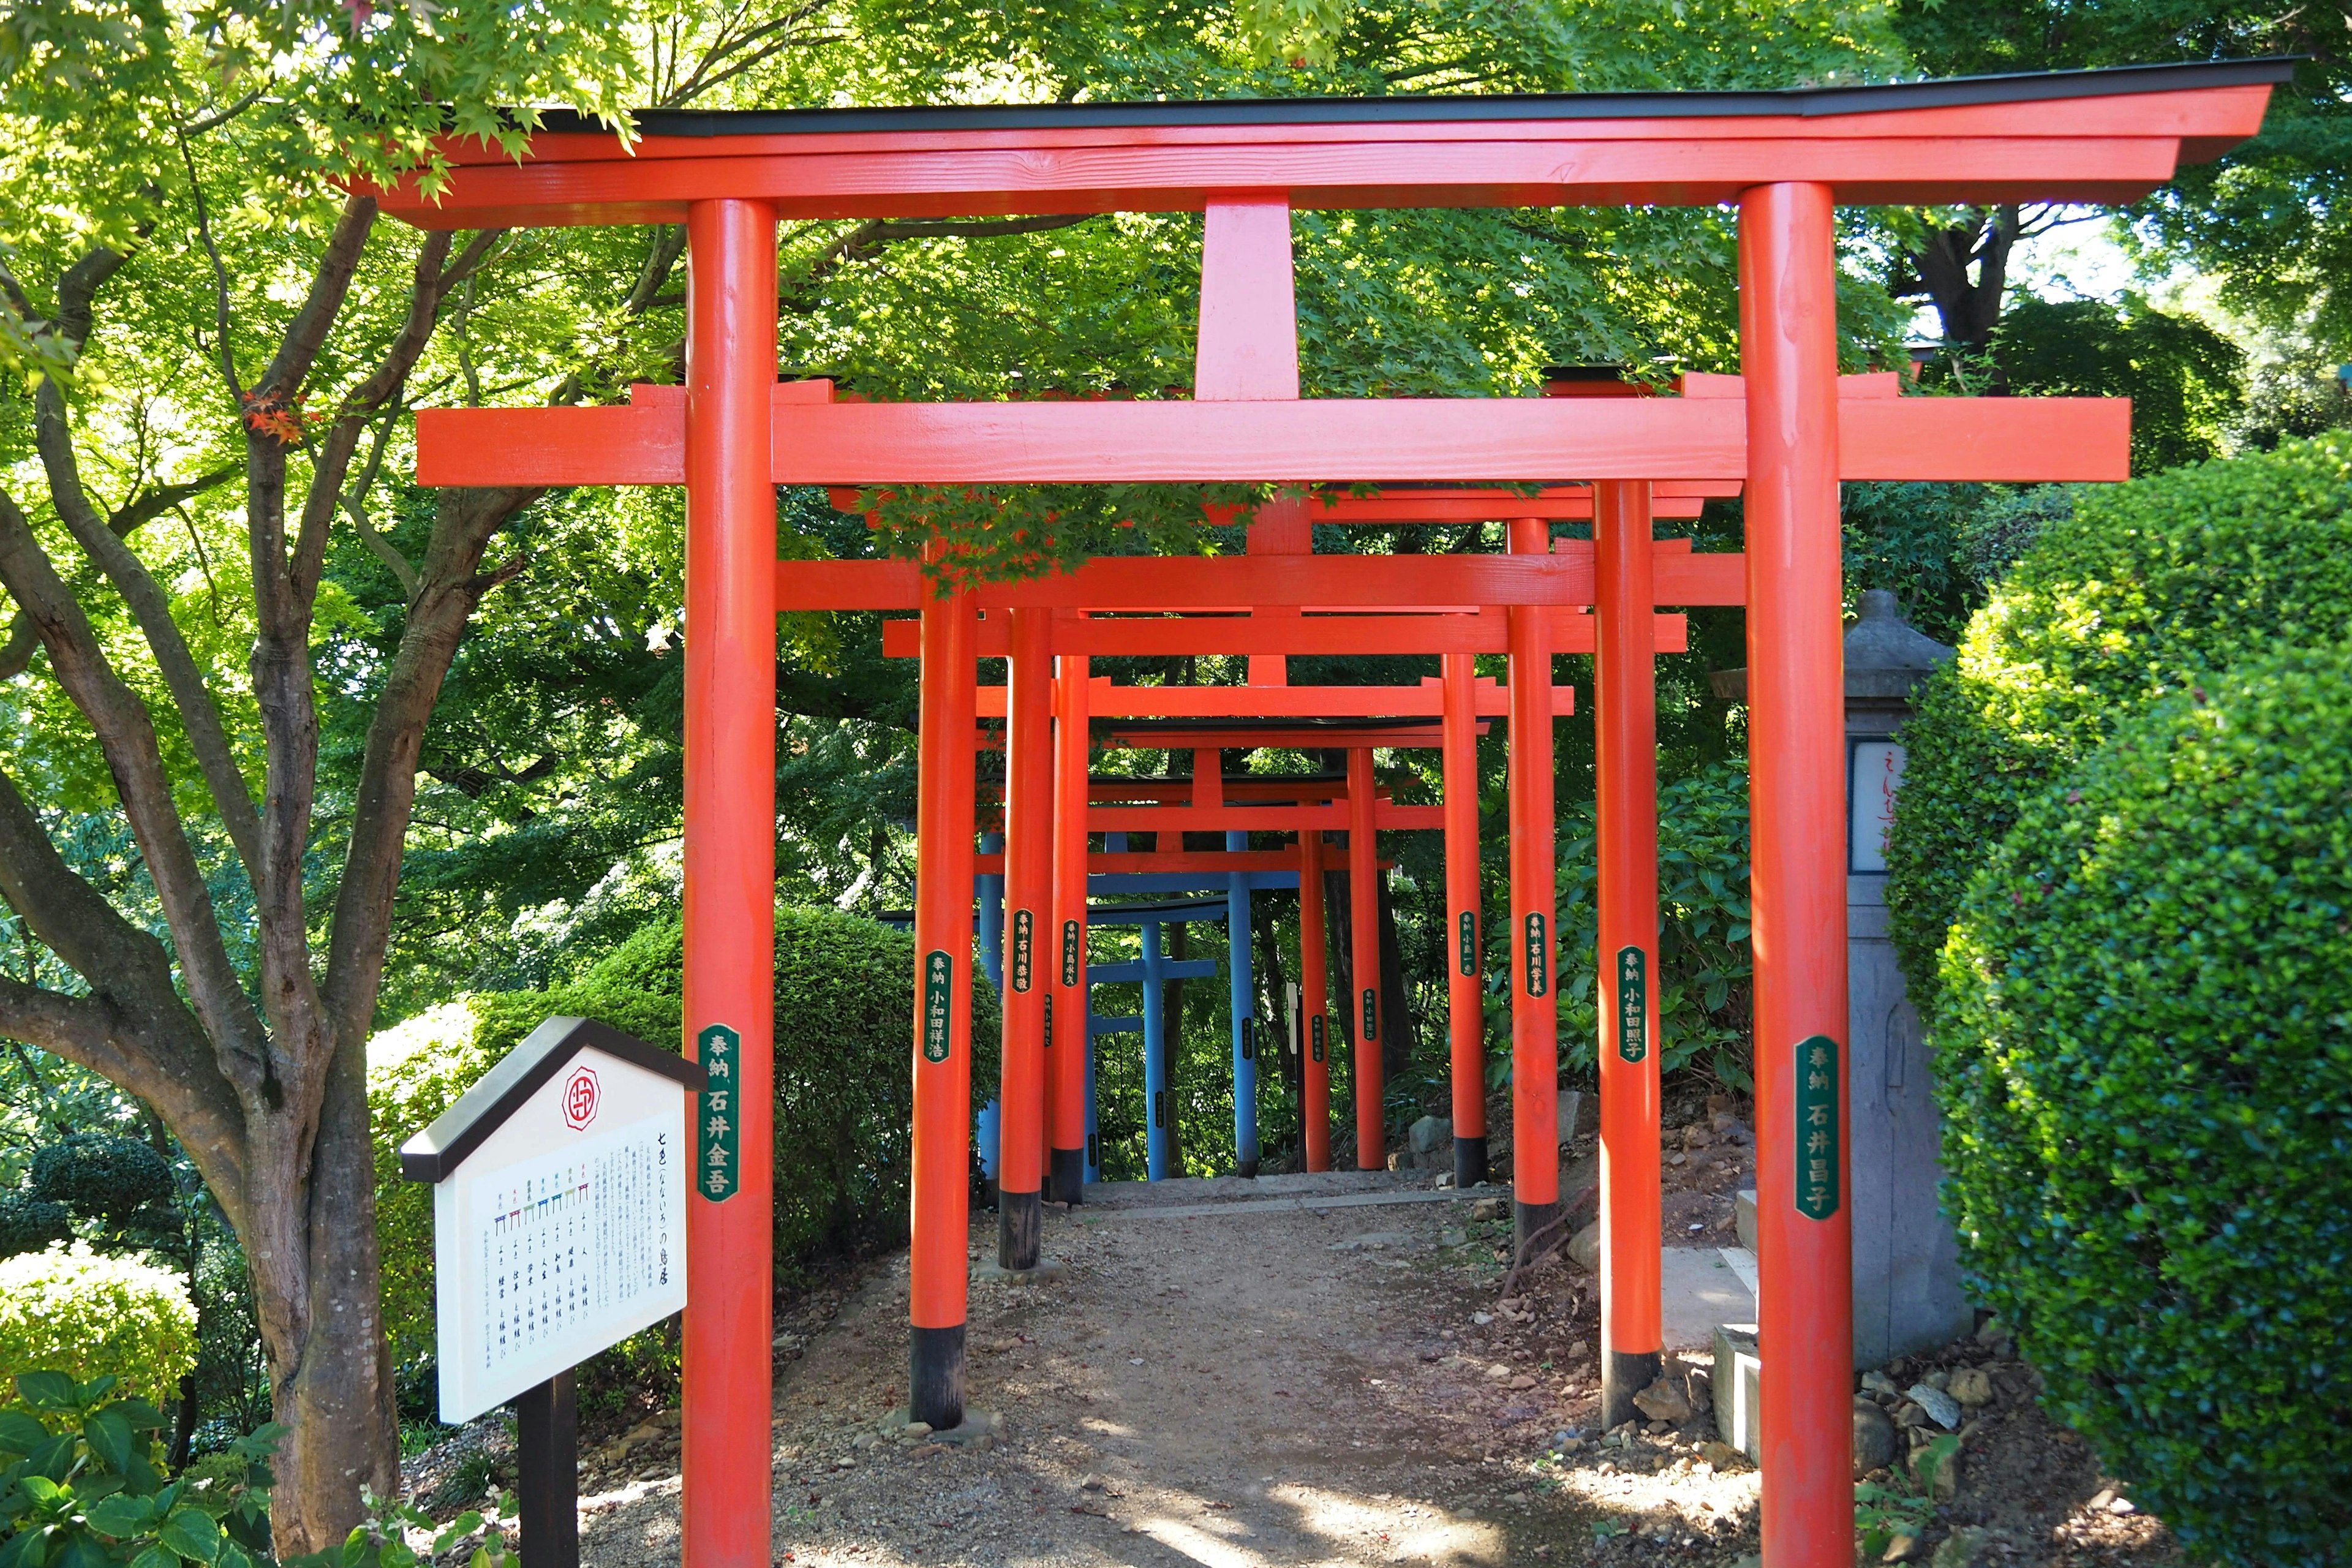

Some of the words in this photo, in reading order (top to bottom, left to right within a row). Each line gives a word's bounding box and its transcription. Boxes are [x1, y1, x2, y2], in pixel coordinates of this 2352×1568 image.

[1017, 913, 1028, 935] 奉納
[1530, 916, 1540, 938] 奉納
[931, 957, 945, 985] 奉納
[1624, 952, 1638, 981] 奉納
[929, 990, 945, 1058] 小和田祥浩
[1624, 988, 1642, 1057] 小和田照子
[707, 1035, 729, 1078] 奉納
[1808, 1046, 1830, 1090] 奉納
[705, 1090, 731, 1194] 石井金吾
[1806, 1104, 1831, 1212] 石井昌子
